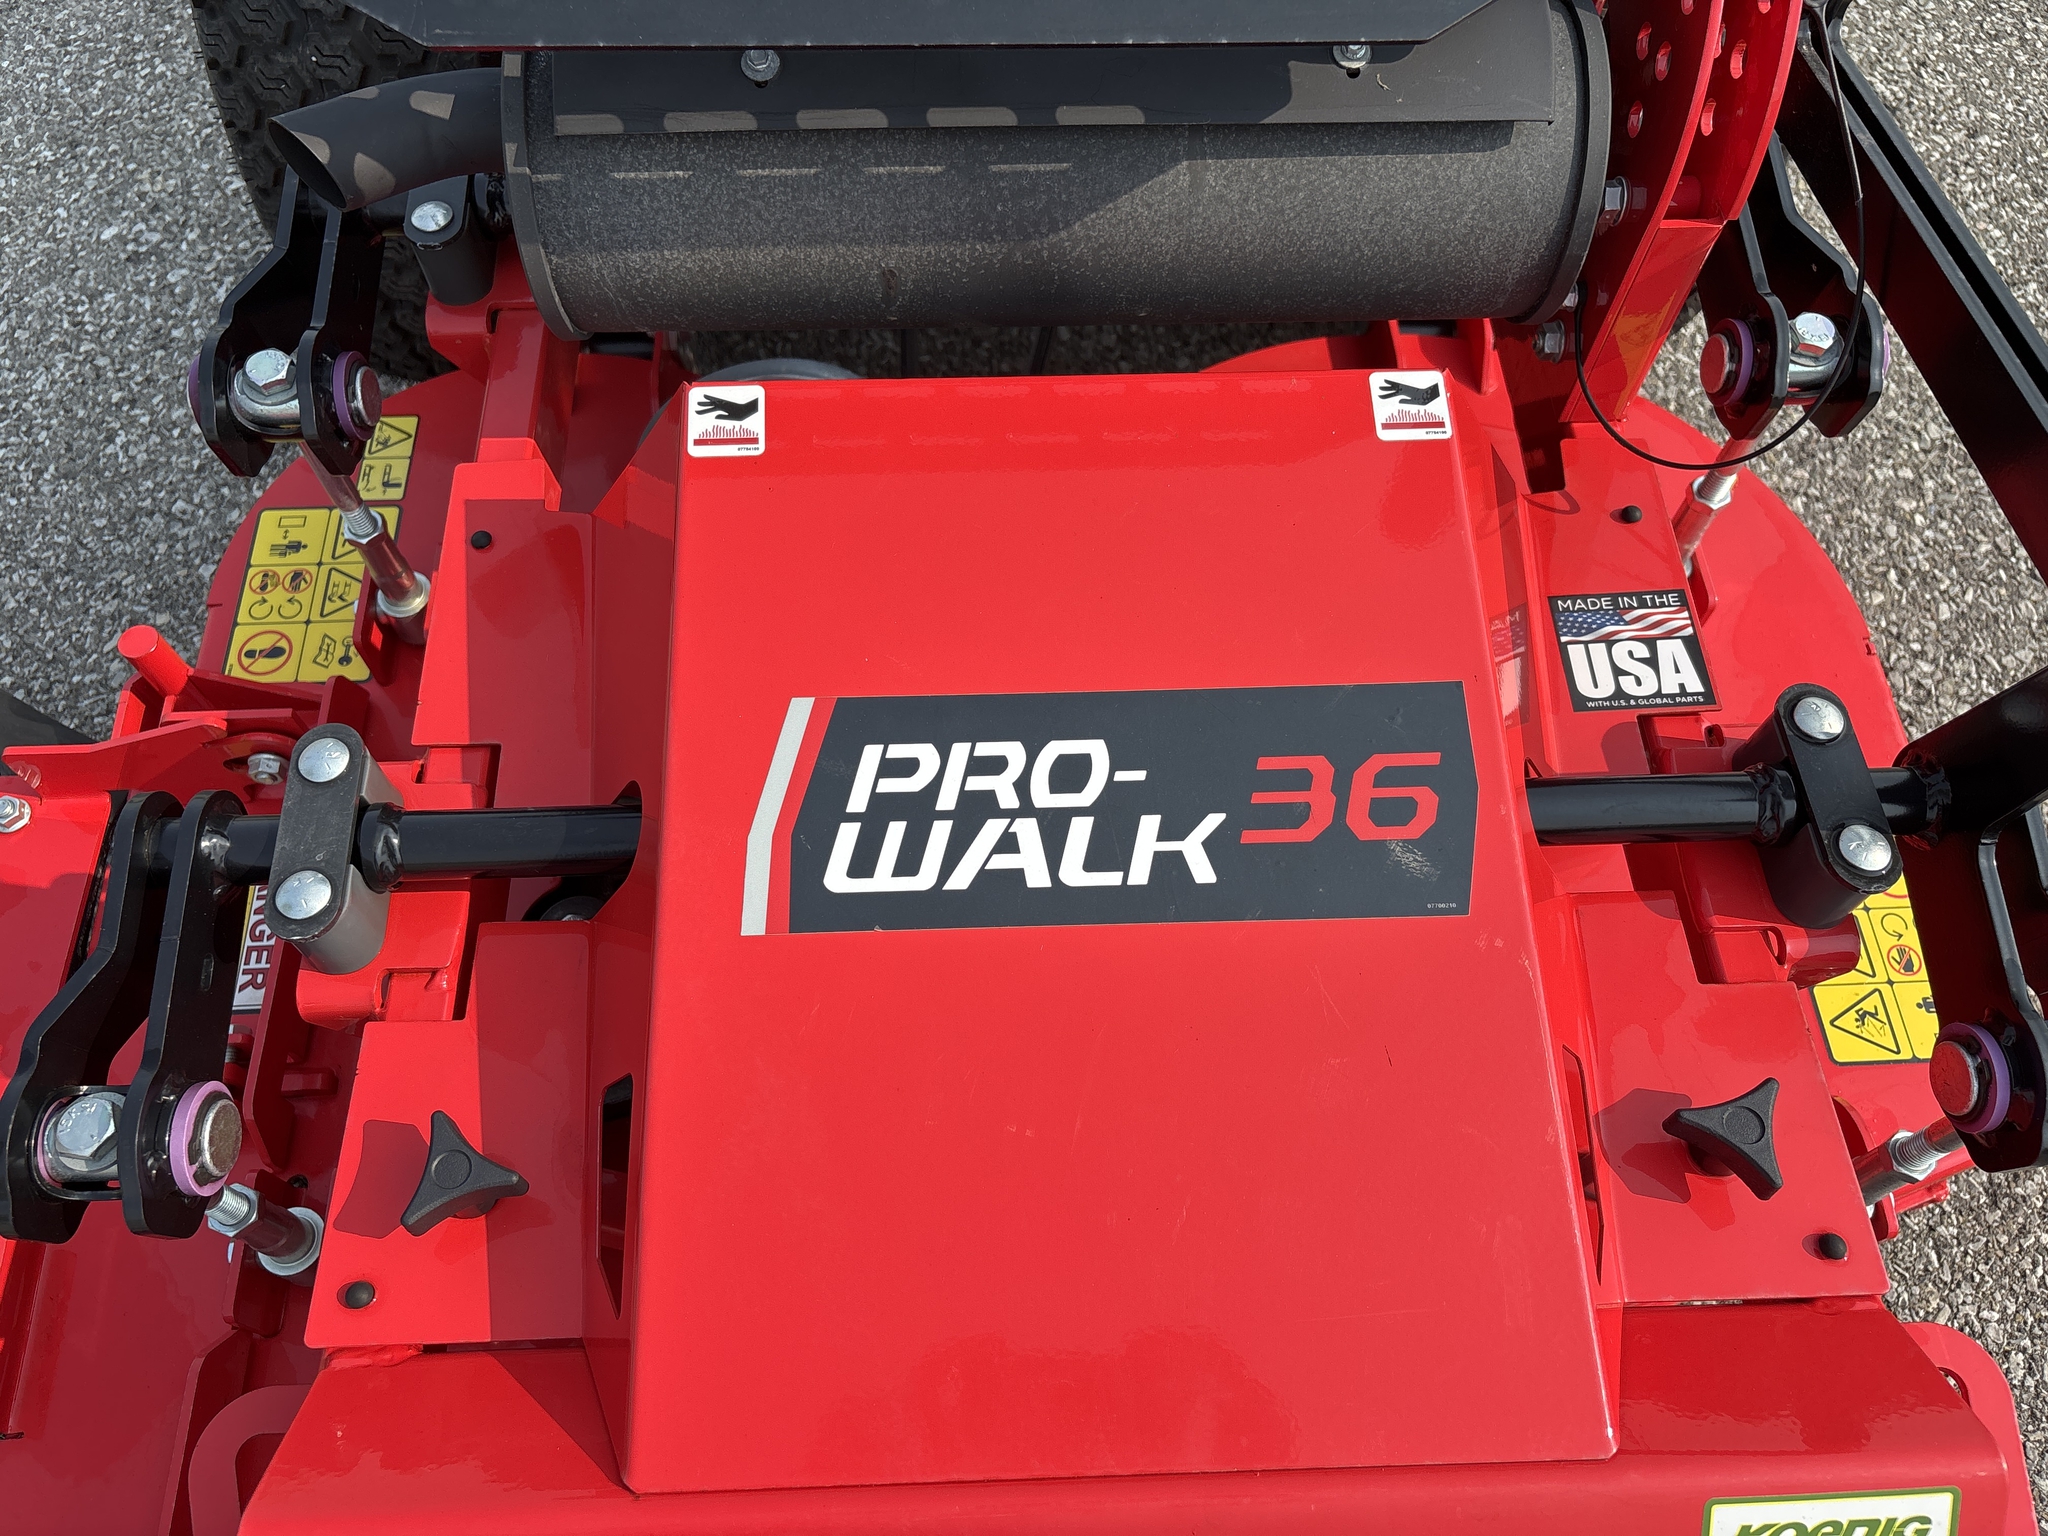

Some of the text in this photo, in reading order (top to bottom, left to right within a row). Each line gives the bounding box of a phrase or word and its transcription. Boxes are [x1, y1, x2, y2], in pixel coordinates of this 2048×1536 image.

[1557, 593, 1681, 611] MADE IN THE
[1567, 638, 1705, 699] USA
[1638, 697, 1674, 705] GLOBAL
[1675, 695, 1704, 703] PARTS
[845, 738, 1147, 813] PRO-
[1240, 751, 1442, 844] 36
[823, 812, 1227, 893] WALK
